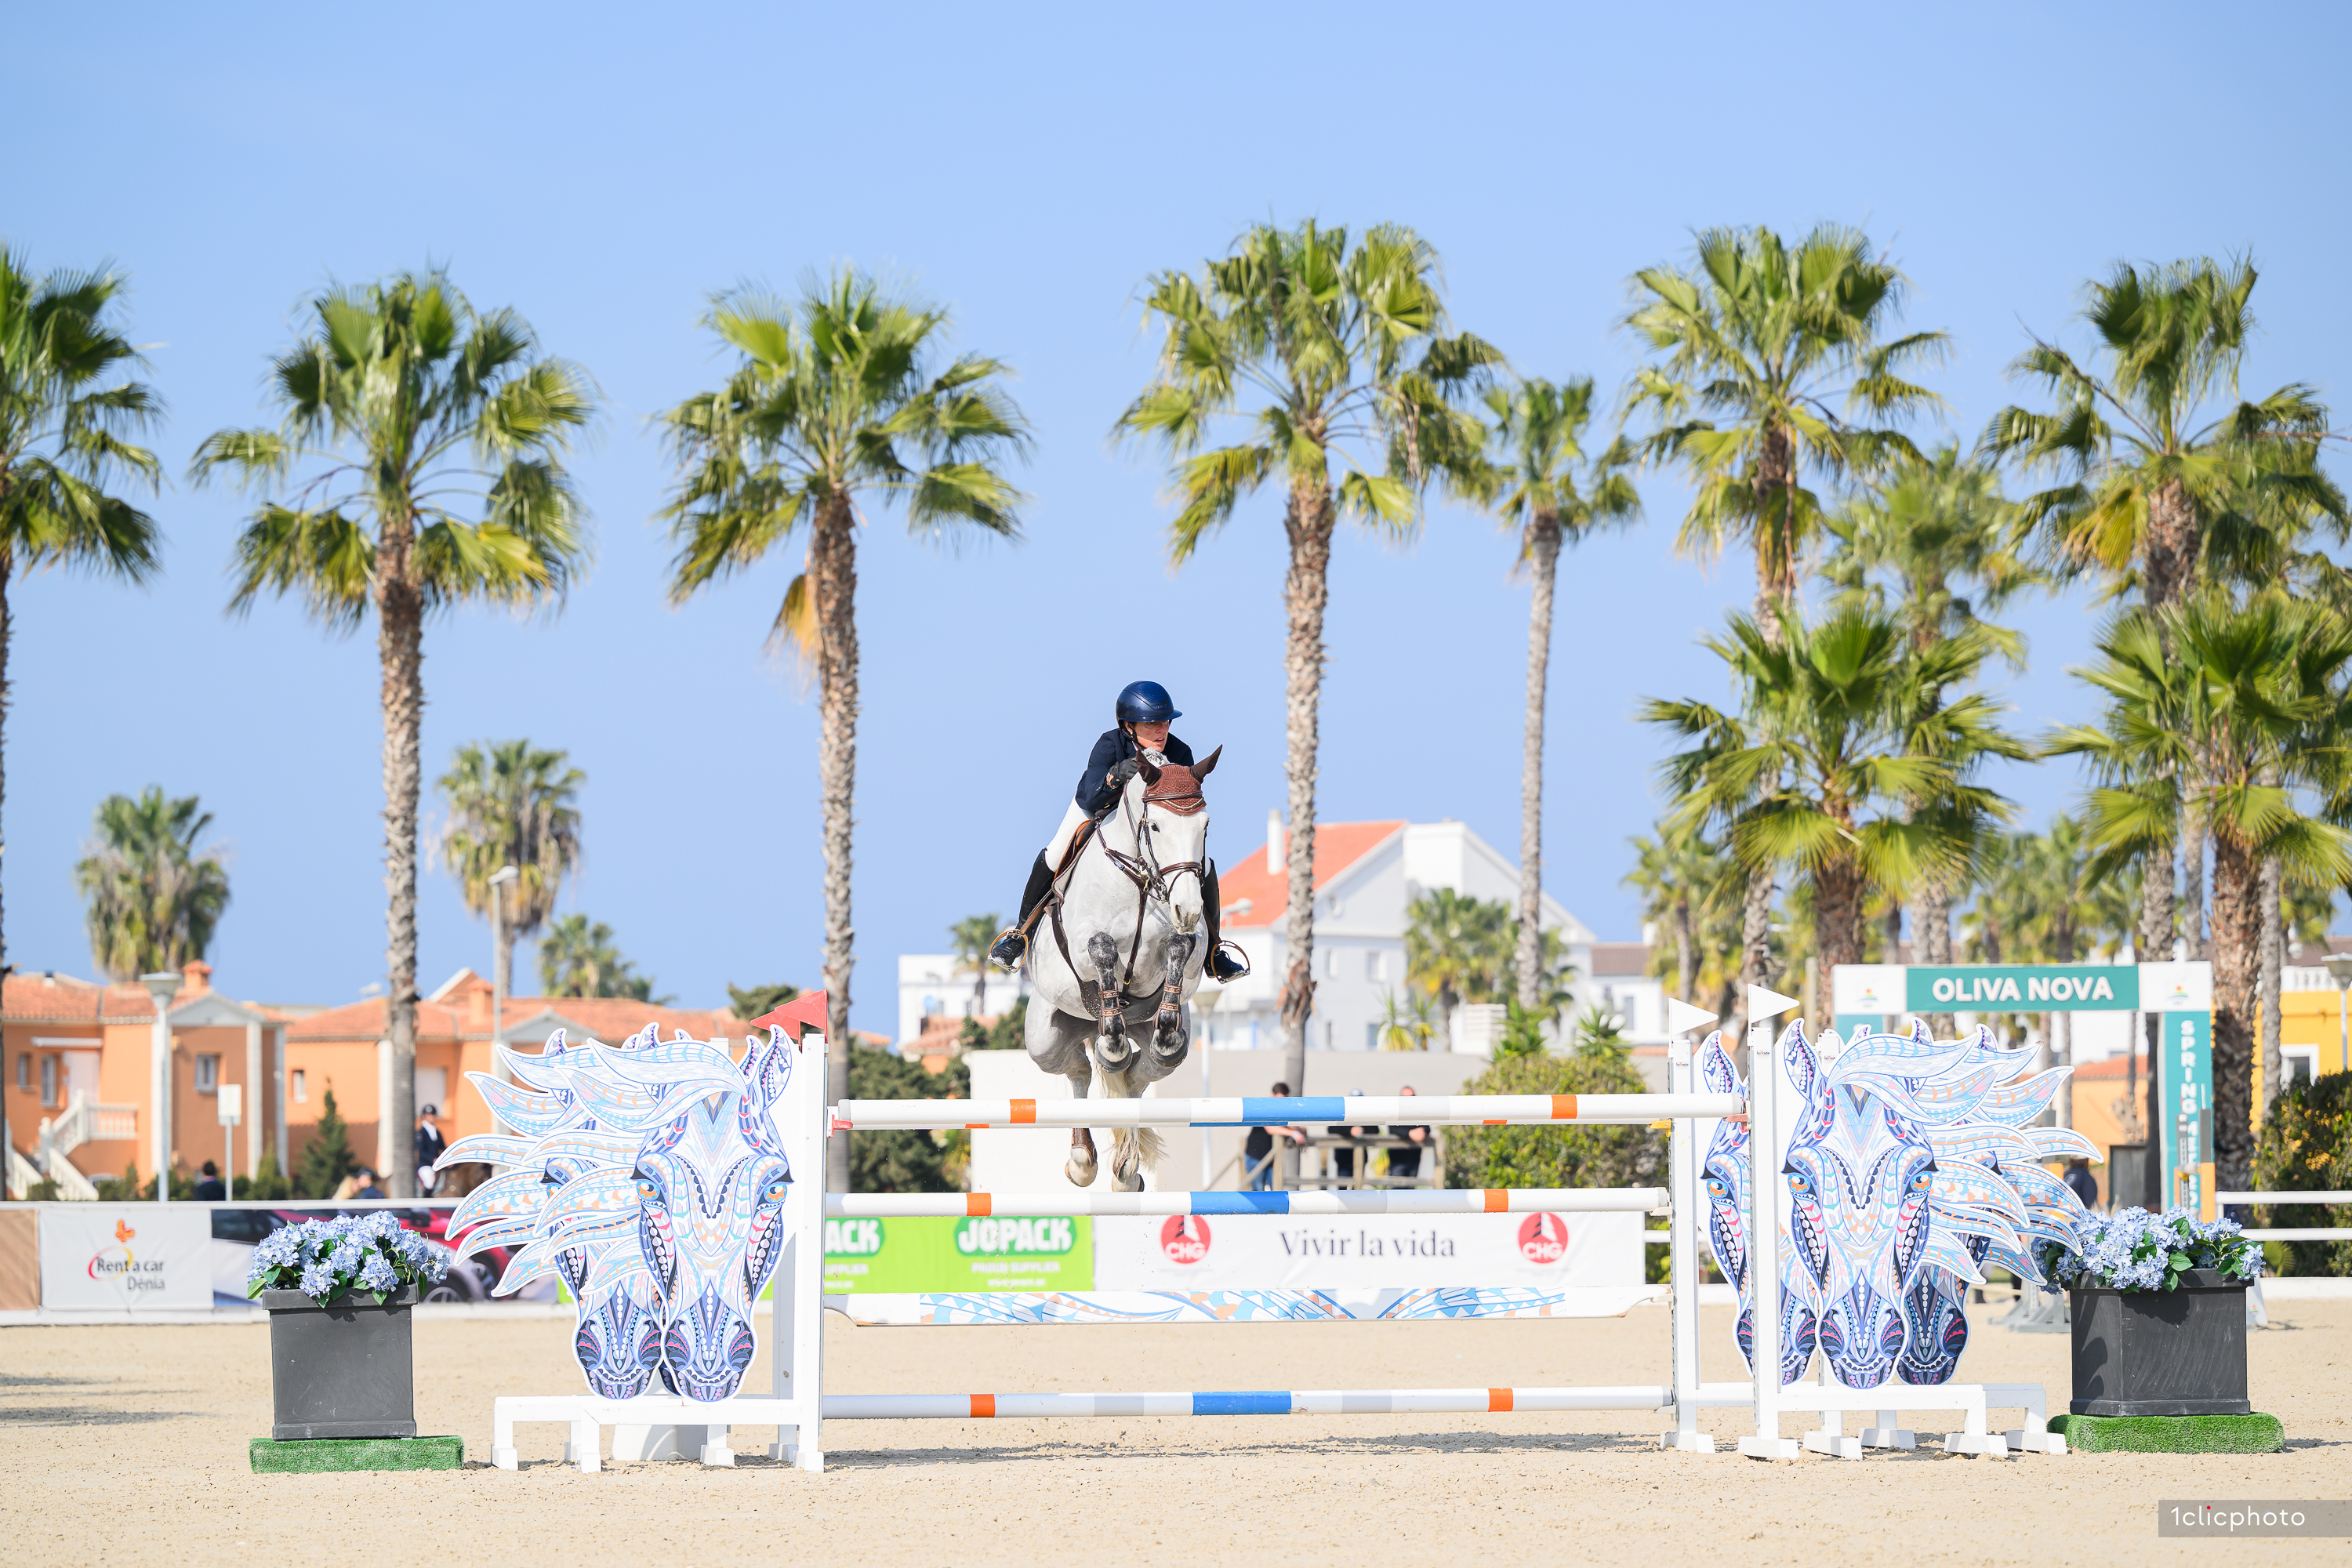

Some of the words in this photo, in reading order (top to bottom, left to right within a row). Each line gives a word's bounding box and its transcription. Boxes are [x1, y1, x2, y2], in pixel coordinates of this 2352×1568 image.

[1932, 978, 2022, 1002] OLIVA
[2027, 976, 2114, 1001] NOVA
[2180, 1019, 2198, 1115] SPRING
[824, 1219, 880, 1254] ACK
[957, 1218, 1073, 1253] JOPACK
[1279, 1229, 1351, 1256] Vivir
[1359, 1230, 1383, 1256] la
[1392, 1230, 1456, 1257] vida
[1165, 1242, 1207, 1260] CHG
[1522, 1242, 1564, 1260] CHG
[96, 1258, 129, 1272] Rent
[132, 1261, 140, 1272] a
[143, 1261, 164, 1272] car
